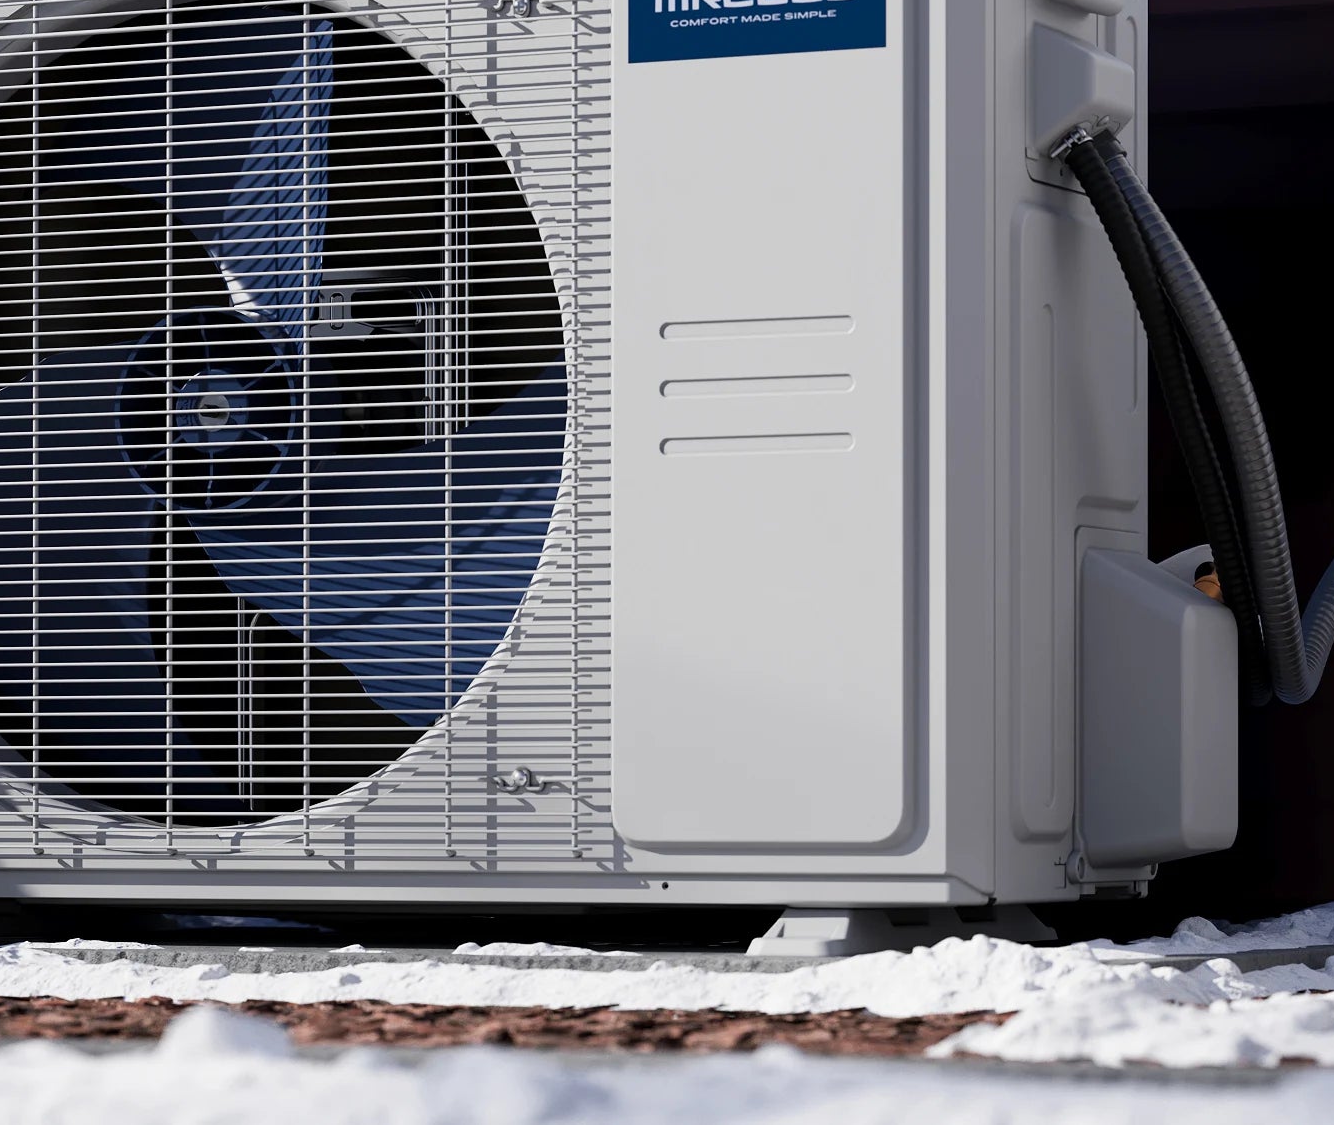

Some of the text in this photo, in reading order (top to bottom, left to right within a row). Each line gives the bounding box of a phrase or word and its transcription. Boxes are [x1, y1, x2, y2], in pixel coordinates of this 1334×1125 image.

[670, 9, 837, 28] COMFORT MADE SIMPLE
